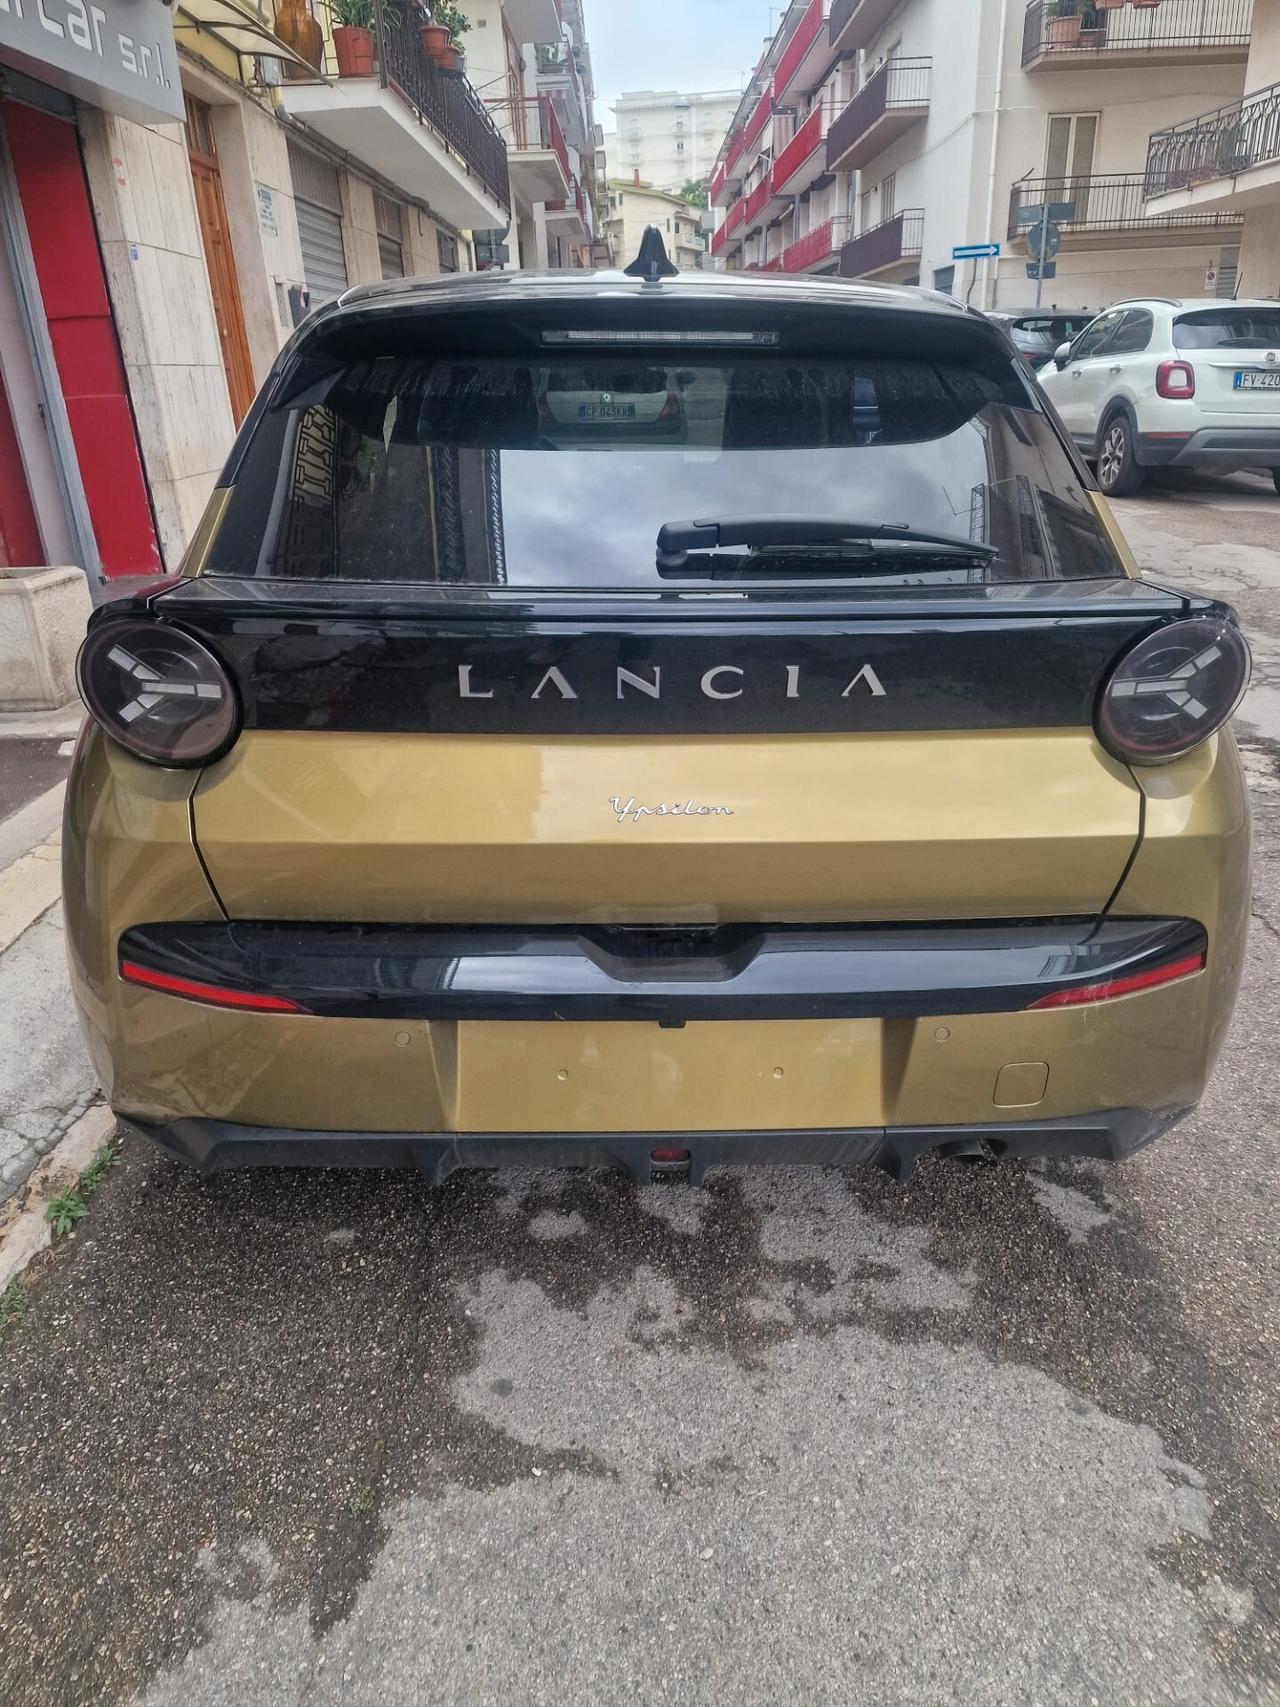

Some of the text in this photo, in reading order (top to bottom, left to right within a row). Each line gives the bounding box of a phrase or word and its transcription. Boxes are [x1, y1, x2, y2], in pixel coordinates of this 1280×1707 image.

[118, 33, 171, 89] s.r.l.
[1243, 374, 1256, 386] FV
[458, 664, 887, 699] LANCIA
[609, 797, 734, 822] Ypsilon
